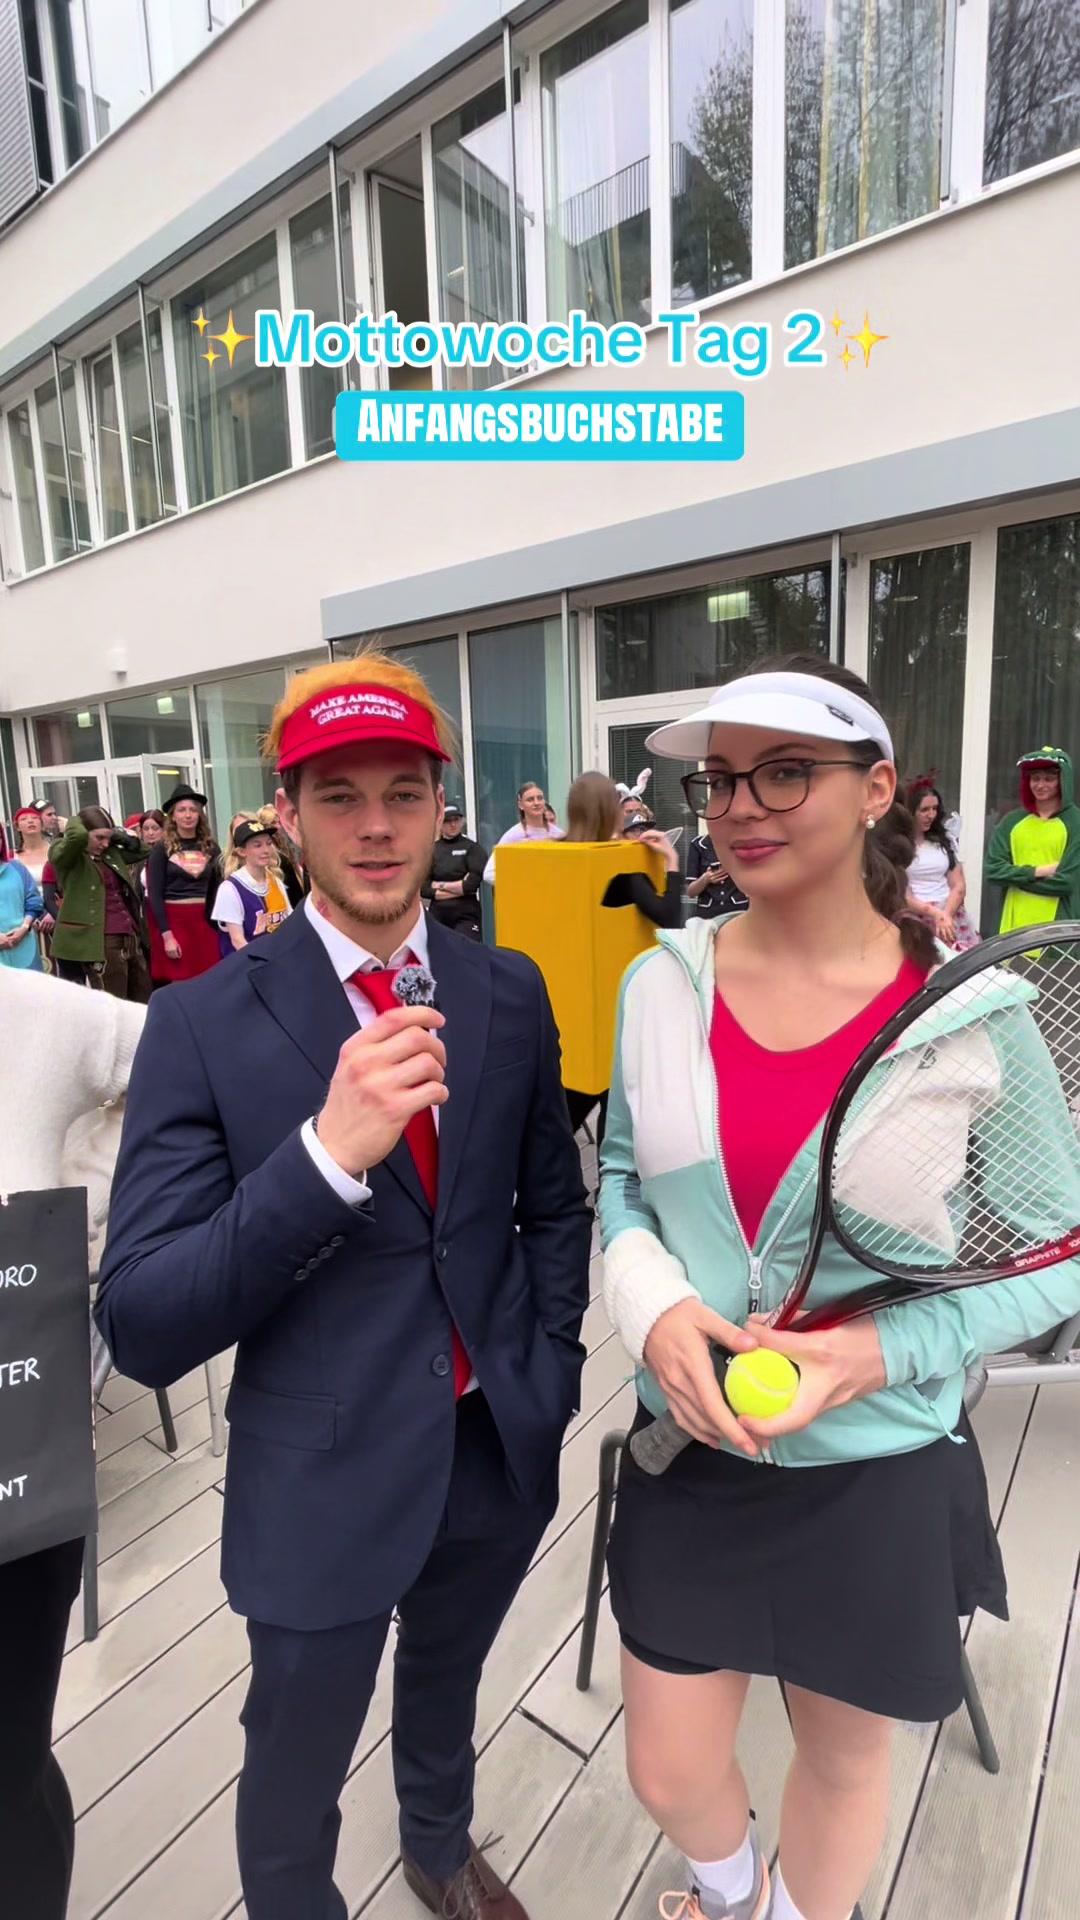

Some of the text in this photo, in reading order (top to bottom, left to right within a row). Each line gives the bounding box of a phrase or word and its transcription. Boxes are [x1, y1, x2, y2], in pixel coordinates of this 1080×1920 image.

[309, 693, 408, 718] MAKE AMERICA
[318, 705, 405, 725] GREAT AGAIN
[1014, 1246, 1061, 1267] GRAPHITE
[0, 1264, 37, 1288] RO
